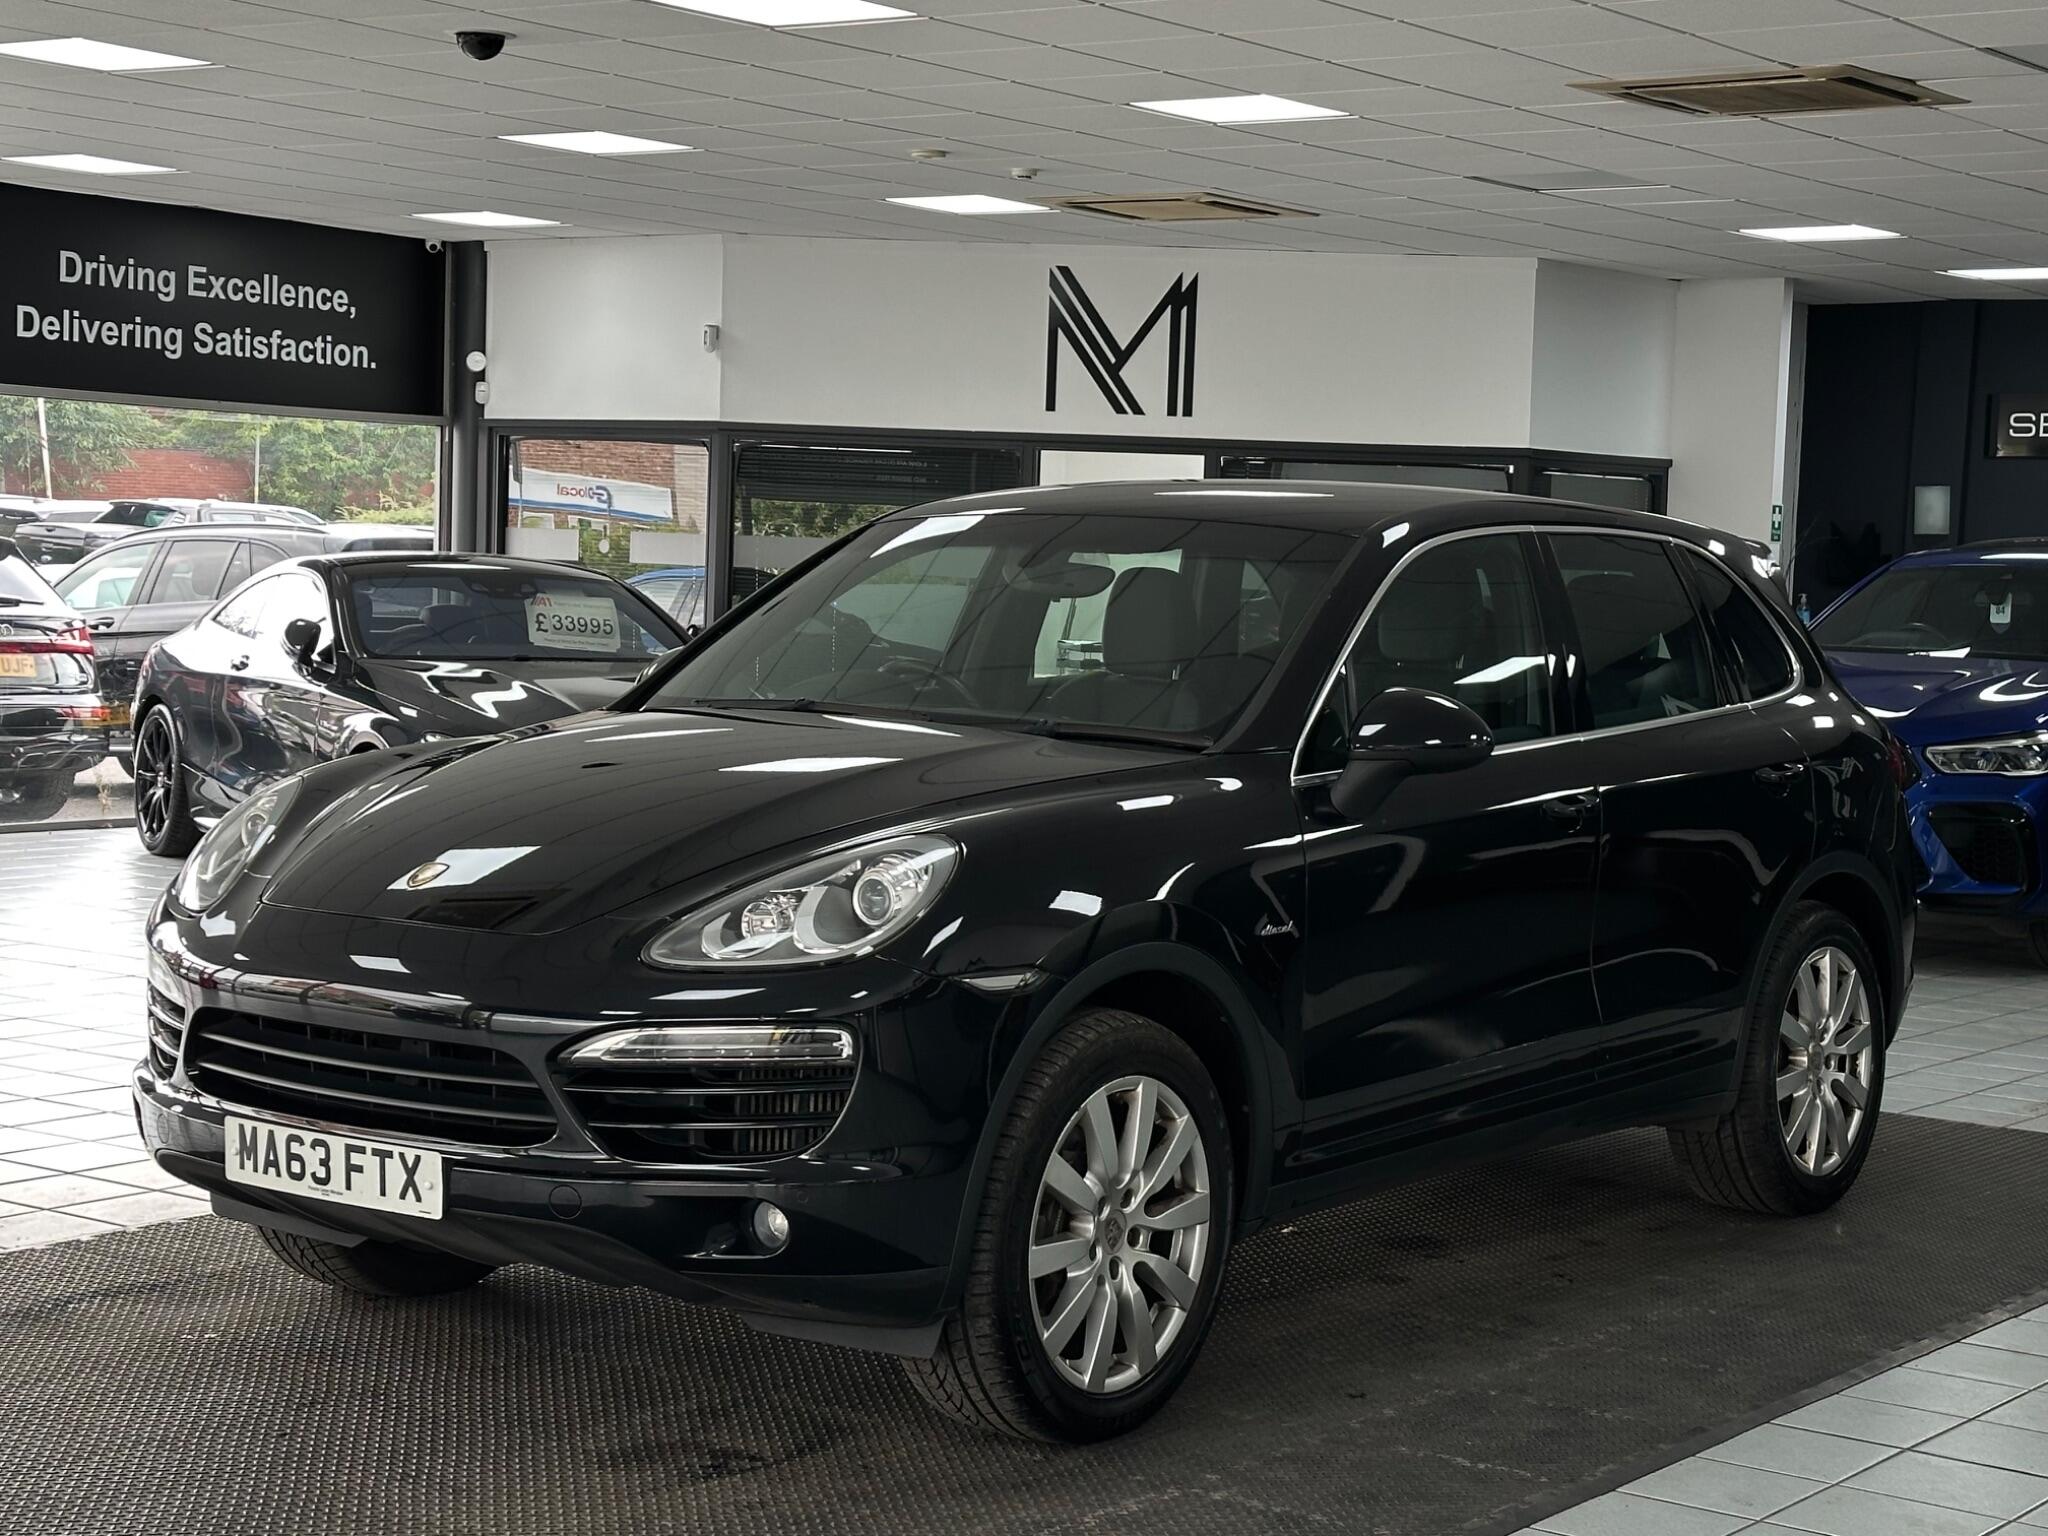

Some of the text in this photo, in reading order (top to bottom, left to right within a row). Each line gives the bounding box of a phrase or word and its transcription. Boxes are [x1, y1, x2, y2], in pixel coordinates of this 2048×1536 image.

[59, 250, 357, 319] Driving Excellence,
[16, 304, 377, 369] Delivering Satisfaction.
[535, 612, 614, 635] £33995
[238, 1123, 423, 1203] MA63 FTX
